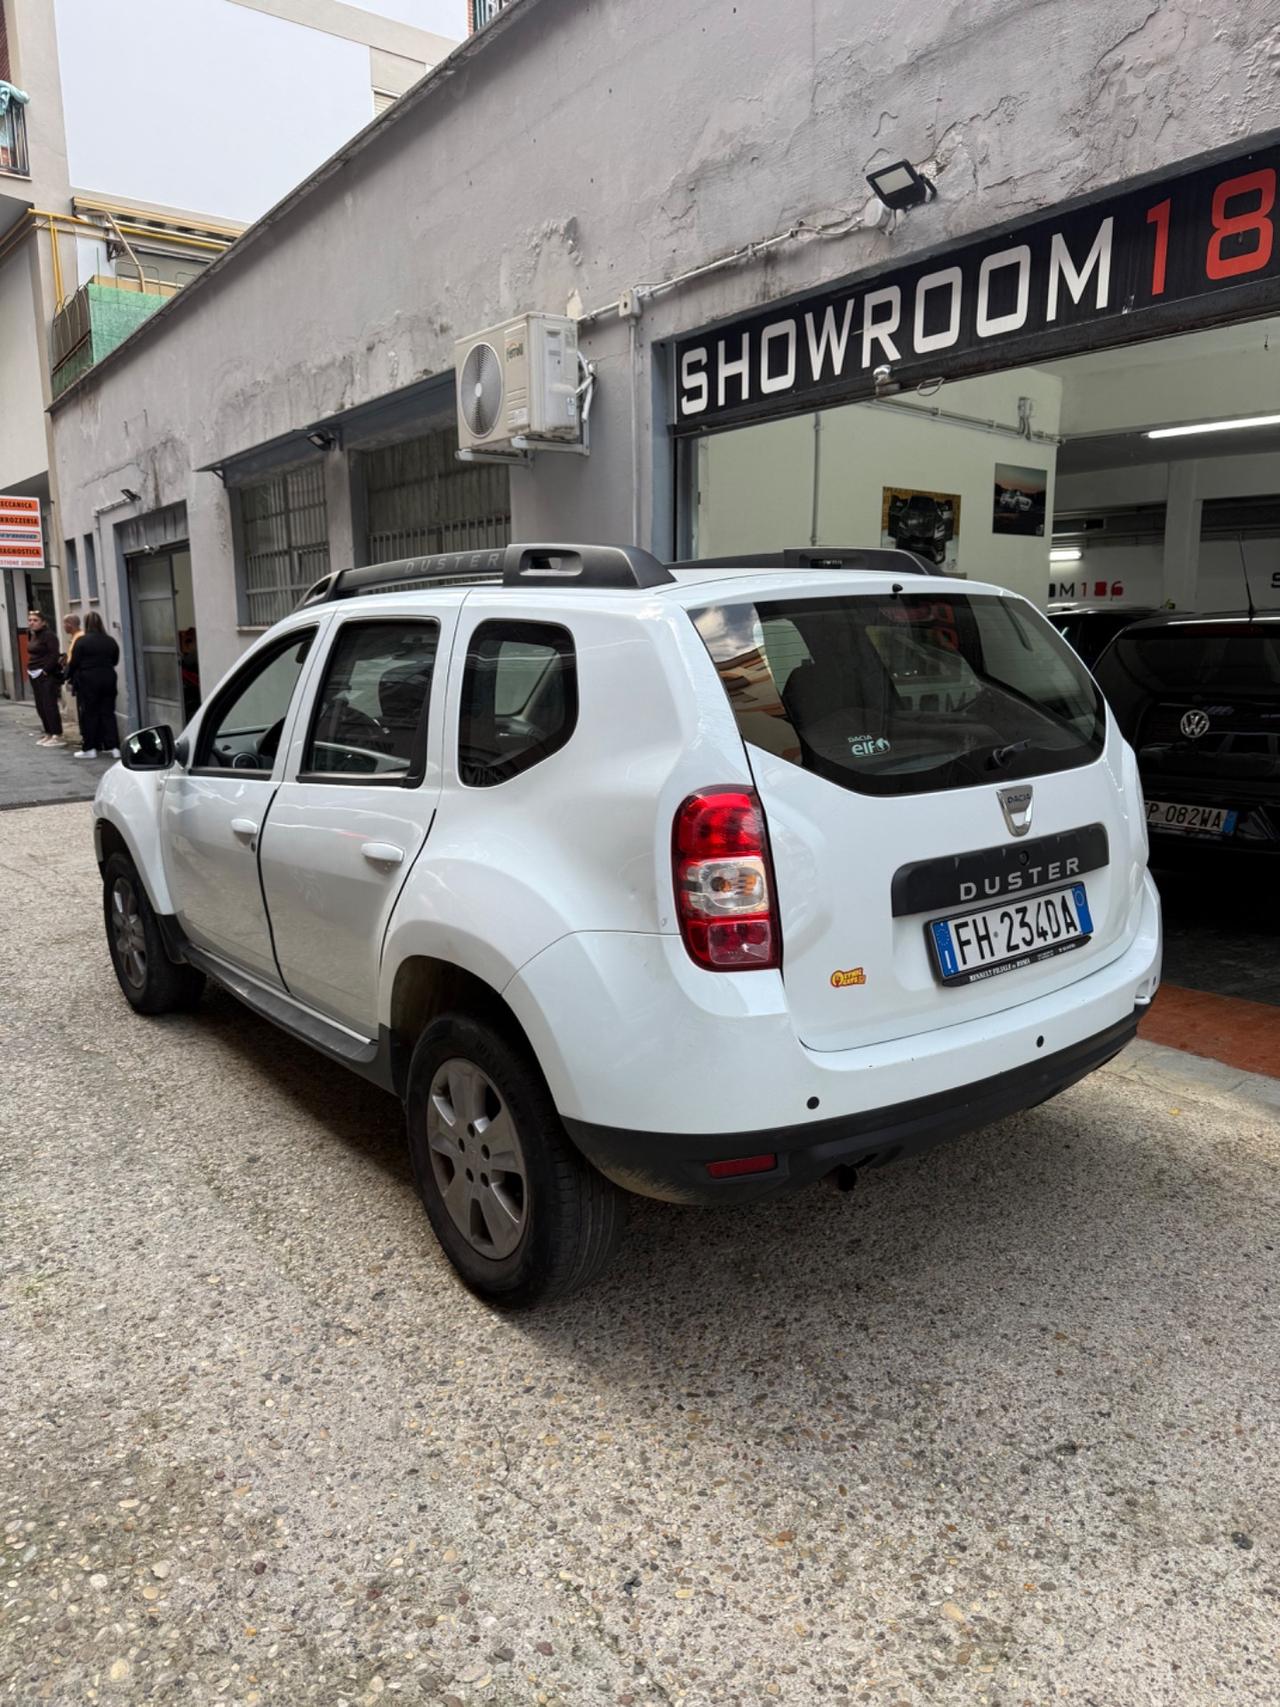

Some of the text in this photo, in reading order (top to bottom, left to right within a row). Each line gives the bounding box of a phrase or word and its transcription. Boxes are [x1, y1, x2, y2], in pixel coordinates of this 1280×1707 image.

[681, 216, 1114, 415] SHOWROOM
[404, 553, 500, 574] DUSTER
[851, 740, 876, 756] elf
[959, 856, 1080, 901] DUSTER
